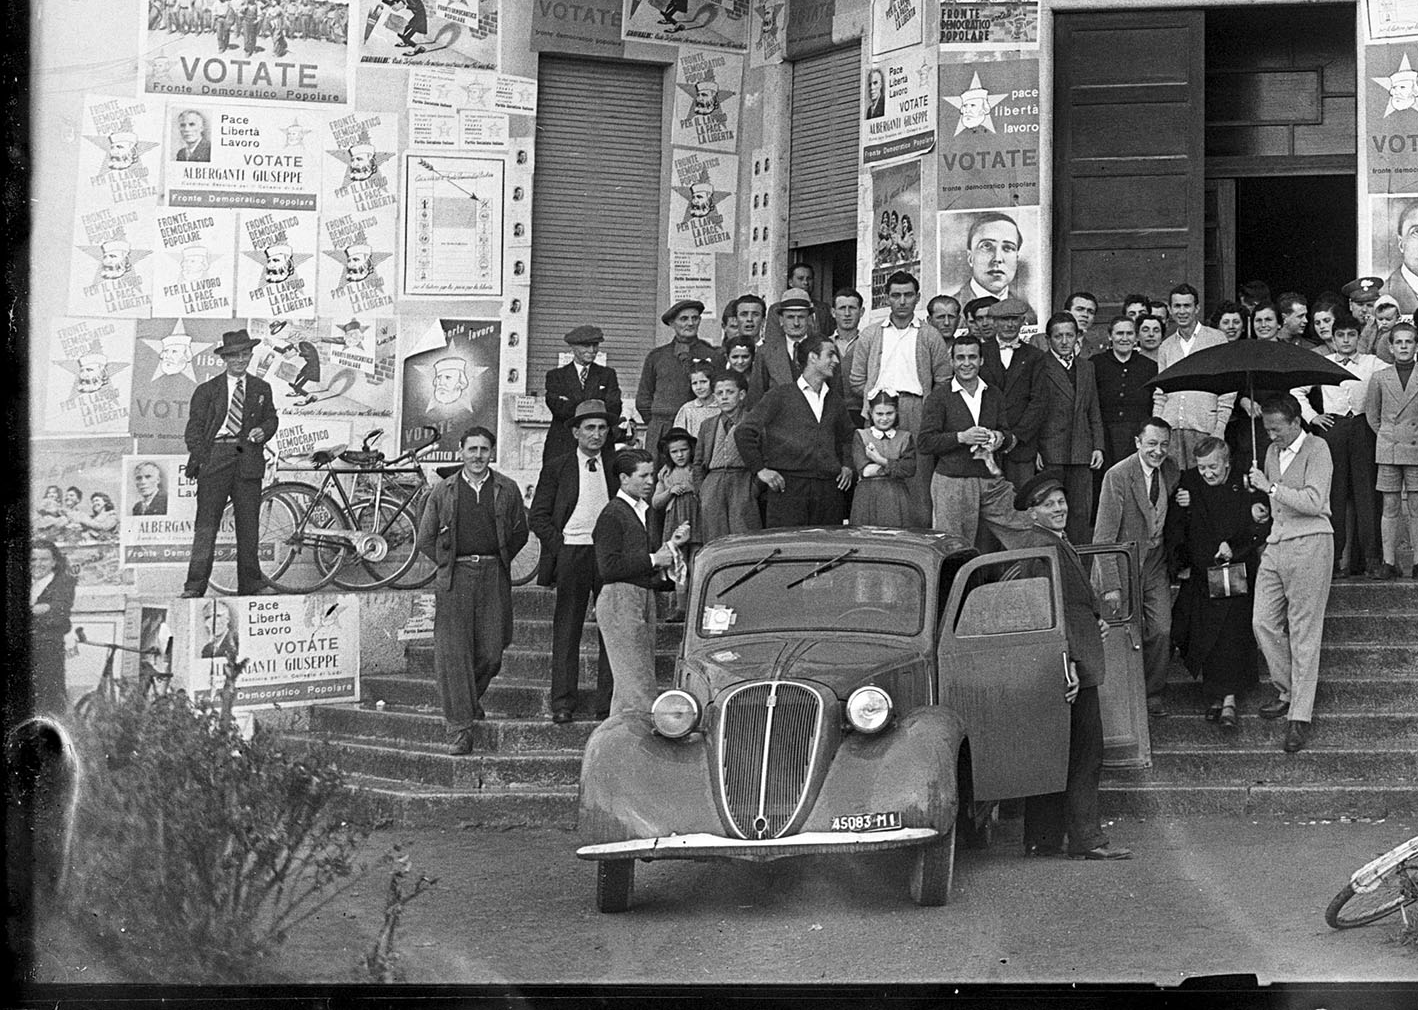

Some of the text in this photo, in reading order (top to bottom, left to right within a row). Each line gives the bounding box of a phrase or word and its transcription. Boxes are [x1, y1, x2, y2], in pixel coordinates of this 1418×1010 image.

[181, 57, 318, 88] VOTATE
[153, 83, 339, 102] Fronte Democratico Popolare
[1011, 89, 1038, 100] pace
[994, 104, 1038, 116] libertà
[221, 114, 249, 125] Pace
[221, 126, 259, 136] Libertà
[1004, 124, 1038, 133] lavoro
[221, 138, 259, 148] Lavoro
[244, 155, 303, 167] VOTATE
[943, 150, 1036, 171] VOTATE
[184, 167, 303, 184] ALBERGANTI GIUSEPPE
[172, 194, 314, 206] Fronte Democratico Popolare
[157, 213, 188, 227] FRONTE
[160, 217, 214, 239] DEMOCRATICO
[163, 231, 201, 248] POPOLARE
[249, 602, 279, 610] Pace
[249, 612, 291, 624] Libertà
[249, 627, 291, 636] Lavoro
[275, 637, 339, 654] VOTATE
[285, 654, 339, 671] GIUSEPPE
[237, 684, 352, 700] Democratico Popolare
[832, 816, 871, 830] 45083
